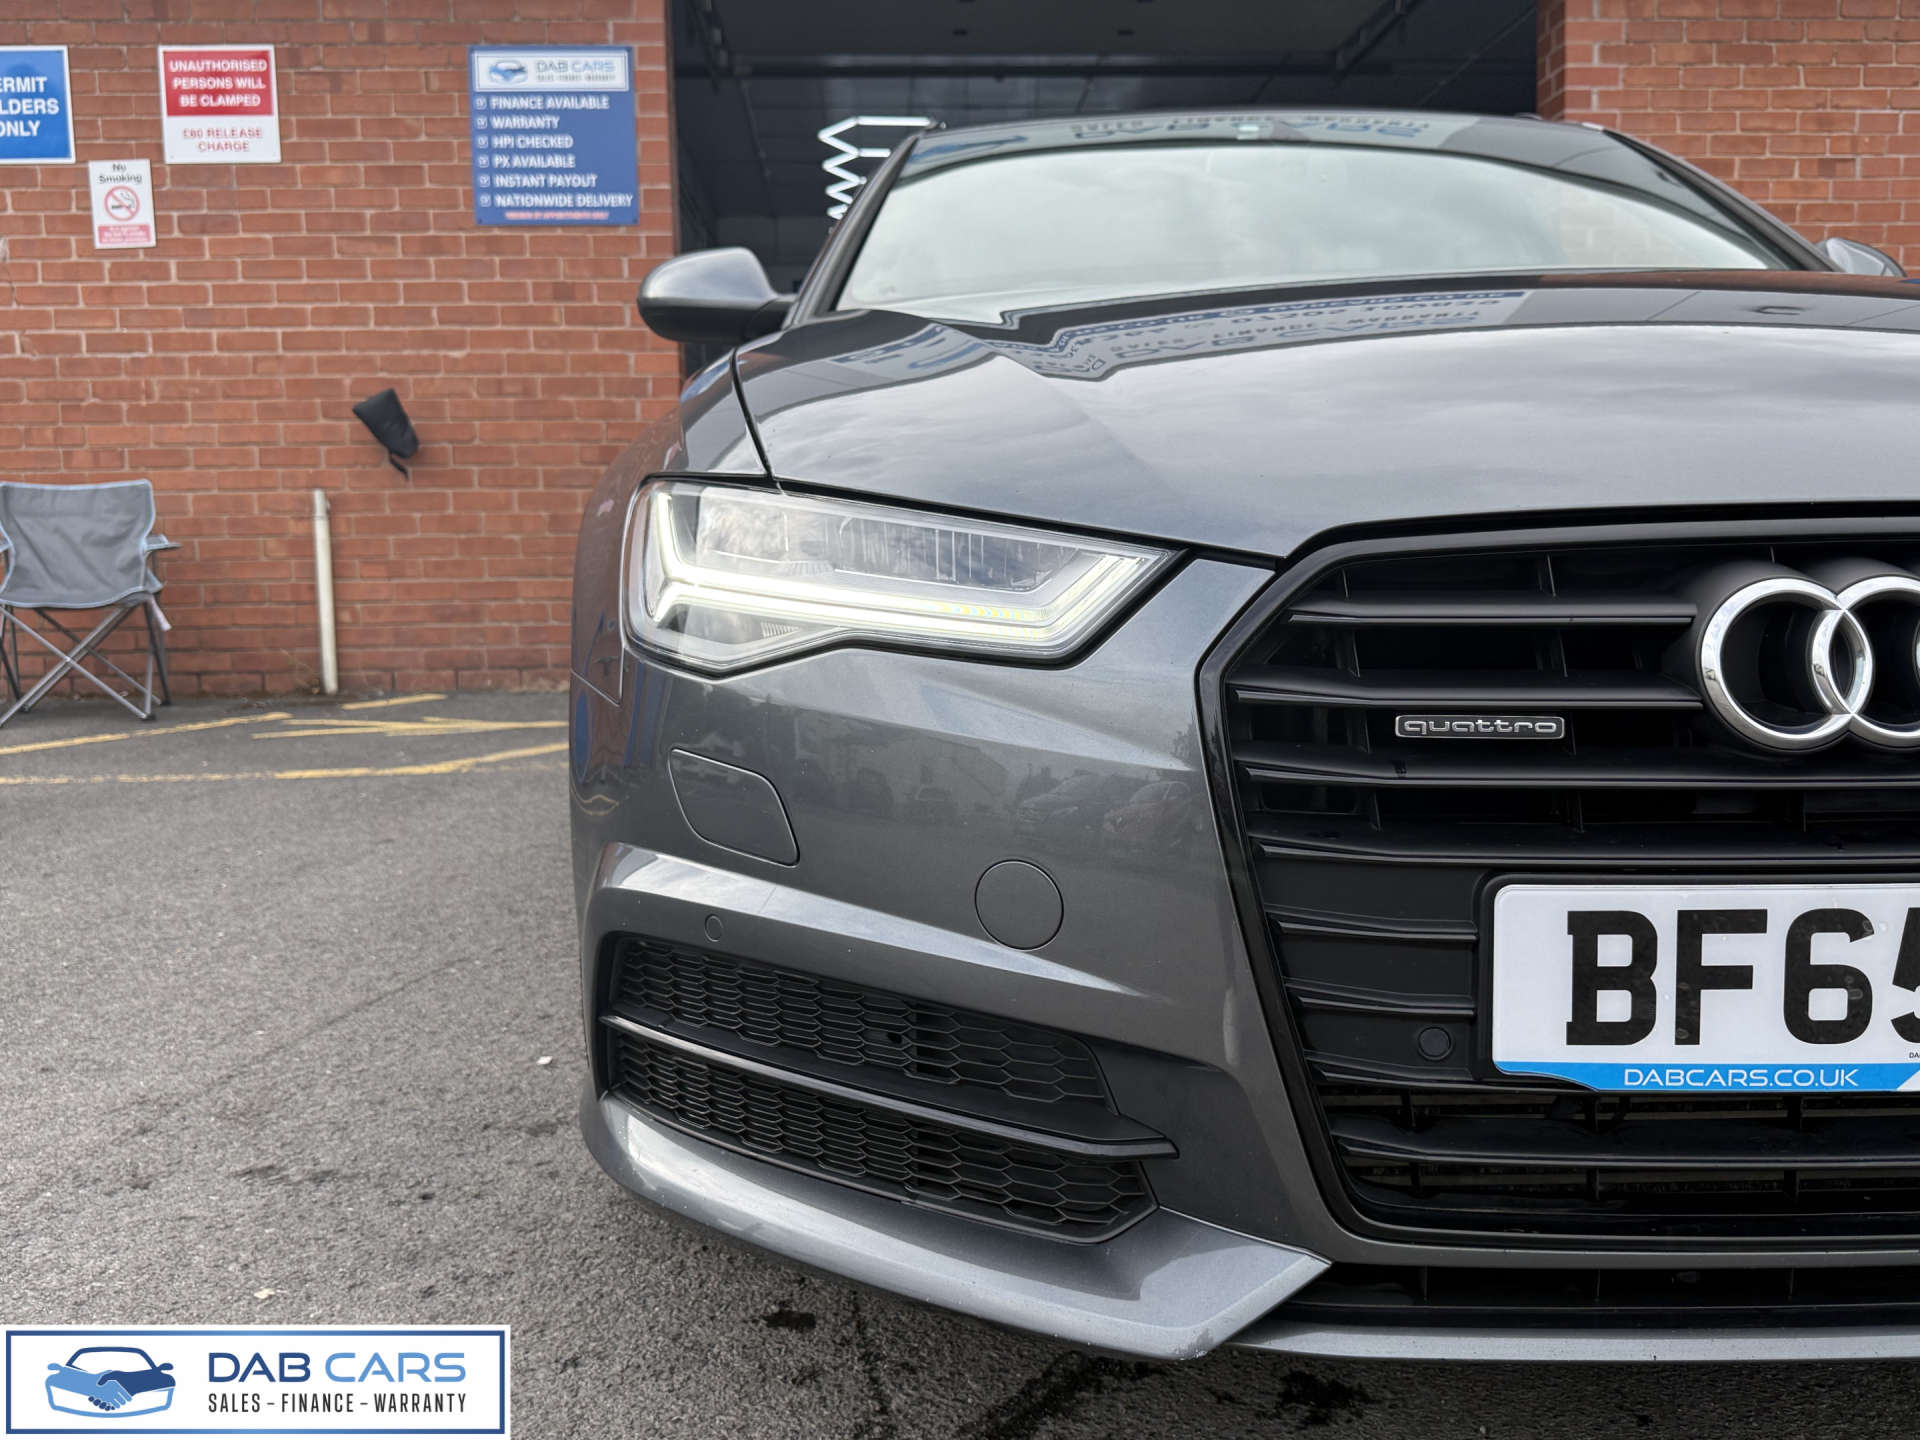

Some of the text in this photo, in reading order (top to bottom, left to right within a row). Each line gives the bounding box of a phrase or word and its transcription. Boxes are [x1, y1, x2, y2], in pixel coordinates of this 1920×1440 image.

[169, 60, 268, 72] UNAUTHORISED
[172, 77, 266, 89] PERSONS WILL
[179, 94, 261, 107] BE CLAMPED
[491, 96, 610, 109] FINANCE AVAILABLE
[491, 116, 560, 129] WARRANTY
[207, 128, 262, 139] RELEASE
[198, 141, 250, 152] CHARGE
[492, 135, 574, 148] HPI CHECKED
[112, 163, 127, 172] No
[493, 154, 576, 168] PX AVAILABLE
[98, 174, 143, 184] Smoking
[494, 174, 598, 187] INSTANT PAYOUT
[495, 194, 633, 207] NATIONWIDE DELIVERY
[1404, 719, 1557, 735] quattro
[1624, 1068, 1859, 1087] DABCARS.CO.UK
